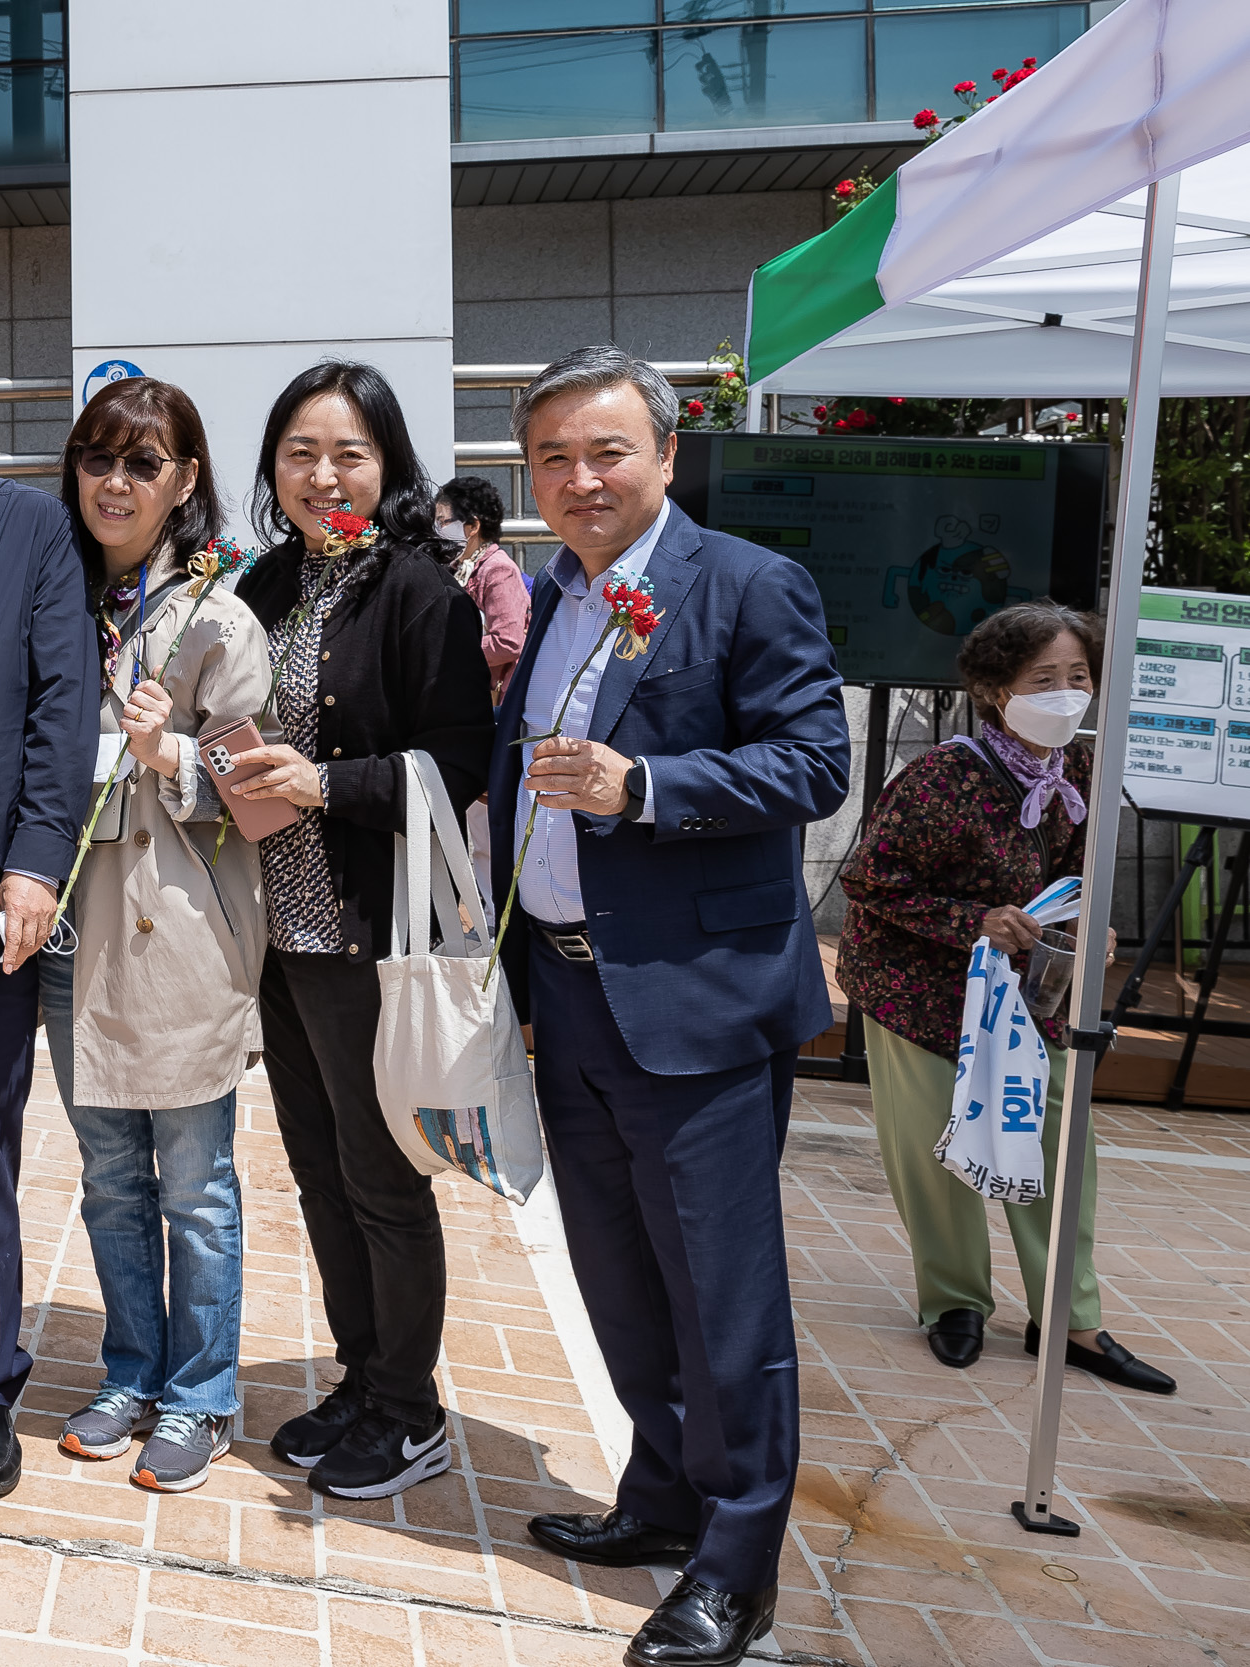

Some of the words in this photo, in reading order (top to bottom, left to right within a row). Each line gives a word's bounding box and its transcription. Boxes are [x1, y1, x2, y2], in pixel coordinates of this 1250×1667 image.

[838, 449, 871, 467] 인해
[935, 453, 948, 469] 수
[950, 453, 976, 470] 있는
[1180, 600, 1219, 622] 노인
[1157, 736, 1174, 747] 또는
[1128, 760, 1146, 771] 가족
